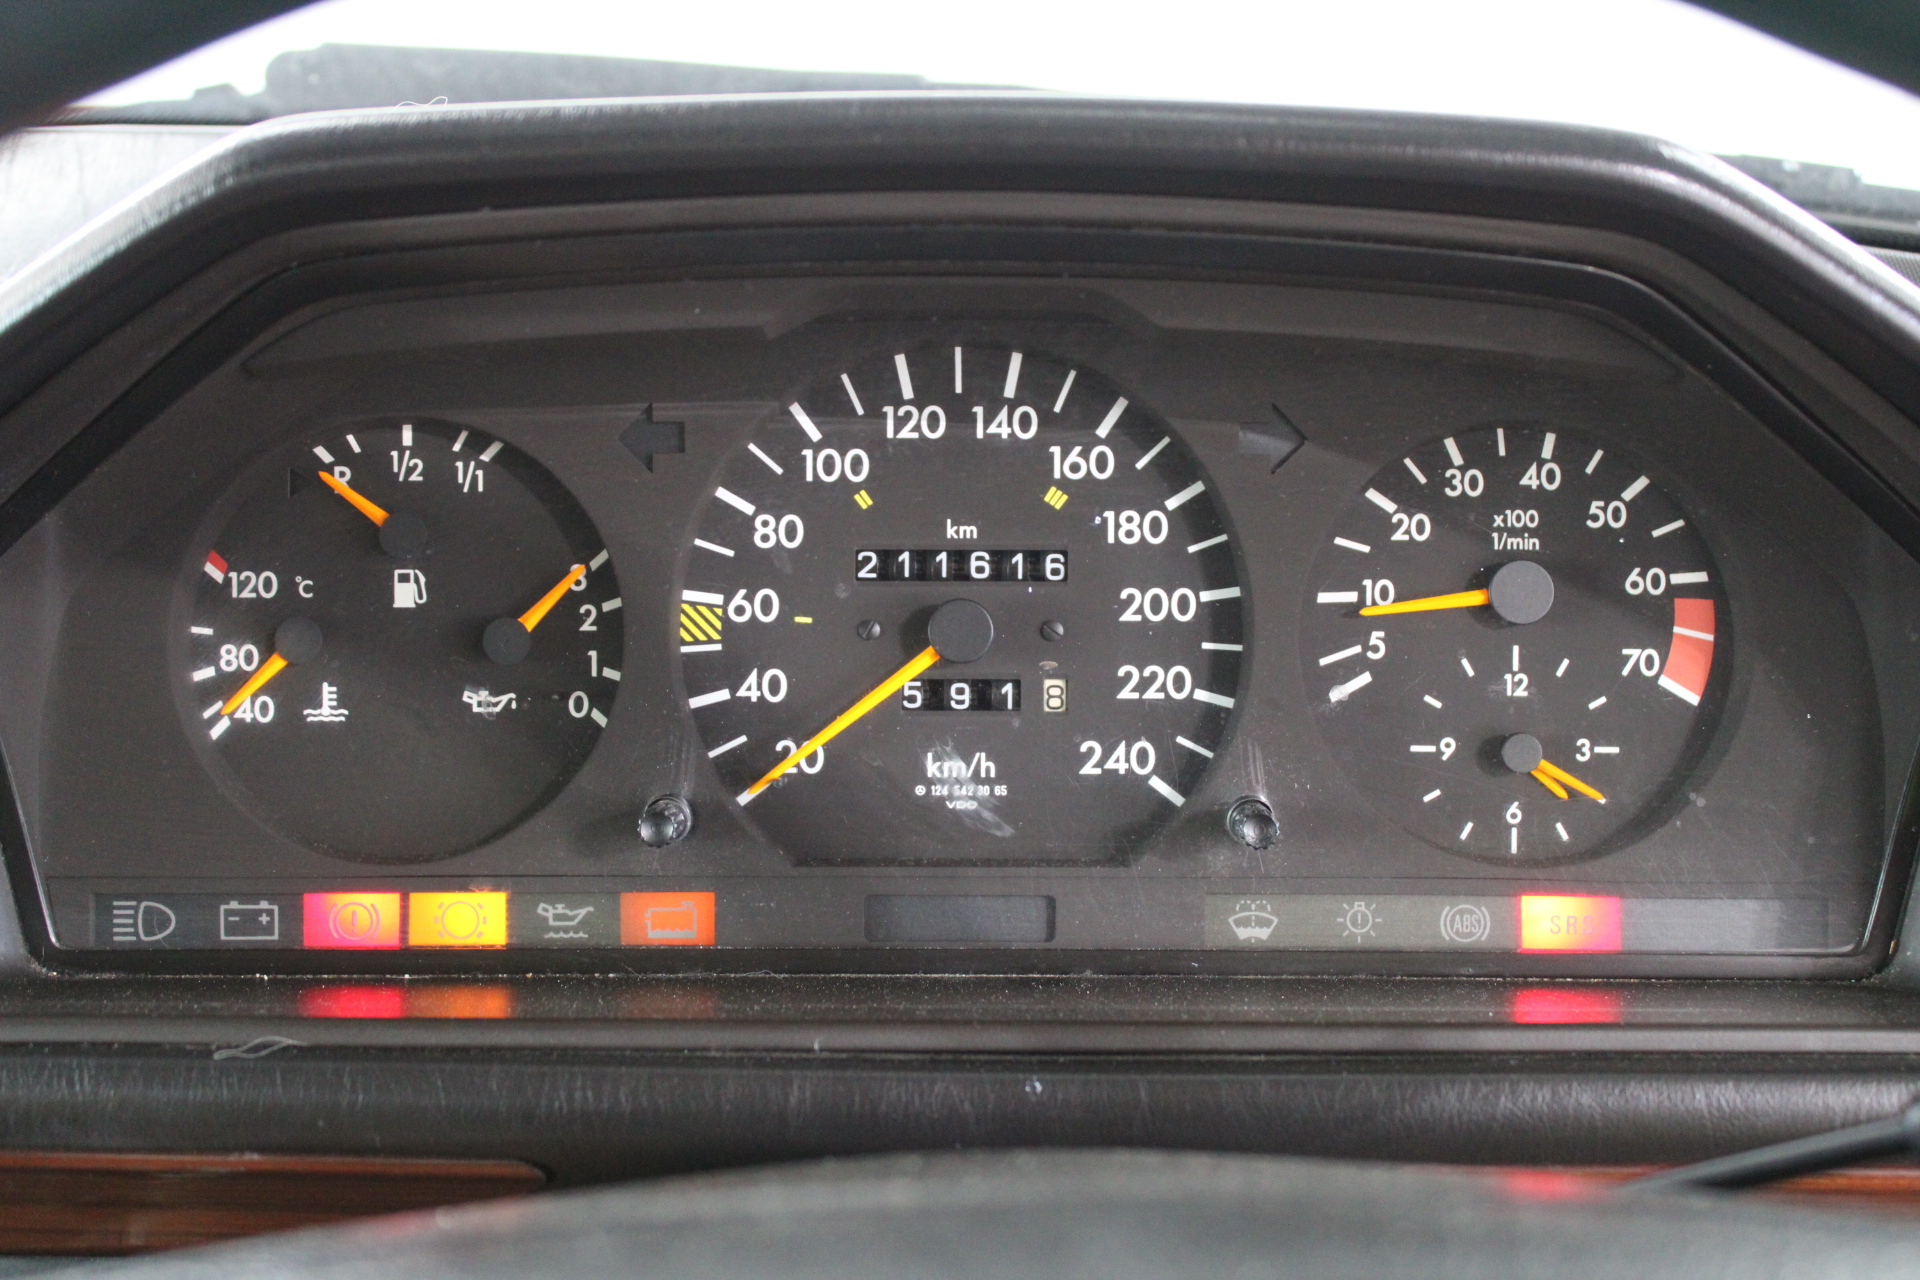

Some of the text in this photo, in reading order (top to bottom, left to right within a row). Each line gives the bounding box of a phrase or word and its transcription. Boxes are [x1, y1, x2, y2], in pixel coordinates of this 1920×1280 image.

[881, 404, 947, 440] 120
[971, 404, 1039, 440] 140
[389, 449, 424, 482] 1/2
[454, 460, 487, 493] 1/1
[800, 448, 870, 483] 100
[1049, 445, 1115, 480] 160
[1519, 461, 1562, 491] 40
[1444, 467, 1485, 497] 30
[945, 519, 979, 540] km
[1102, 510, 1169, 545] 180
[1390, 511, 1432, 542] 20
[1492, 509, 1540, 529] x100
[1585, 500, 1628, 530] 50
[753, 513, 804, 549] 80
[1491, 532, 1541, 552] 1/min
[228, 570, 279, 599] 120
[1361, 578, 1396, 607] 10
[1624, 567, 1667, 596] 60
[578, 603, 598, 631] 2
[727, 588, 780, 623] 60
[1118, 587, 1197, 623] 200
[218, 643, 260, 672] 80
[1366, 631, 1387, 660] 5
[587, 650, 598, 677] 1
[1621, 649, 1661, 678] 70
[735, 667, 789, 703] 40
[1116, 664, 1193, 701] 220
[1503, 672, 1529, 698] 12
[232, 694, 275, 724] 40
[567, 690, 590, 719] 0
[774, 739, 826, 775] 20
[1078, 740, 1157, 776] 240
[1438, 736, 1457, 762] 9
[1575, 738, 1592, 763] 3
[926, 751, 996, 779] km/h
[930, 785, 948, 796] 124
[994, 785, 1008, 796] 65
[945, 800, 978, 809] VDO
[1504, 801, 1523, 825] 6
[1452, 914, 1480, 933] ABS
[1549, 914, 1594, 935] SRS
